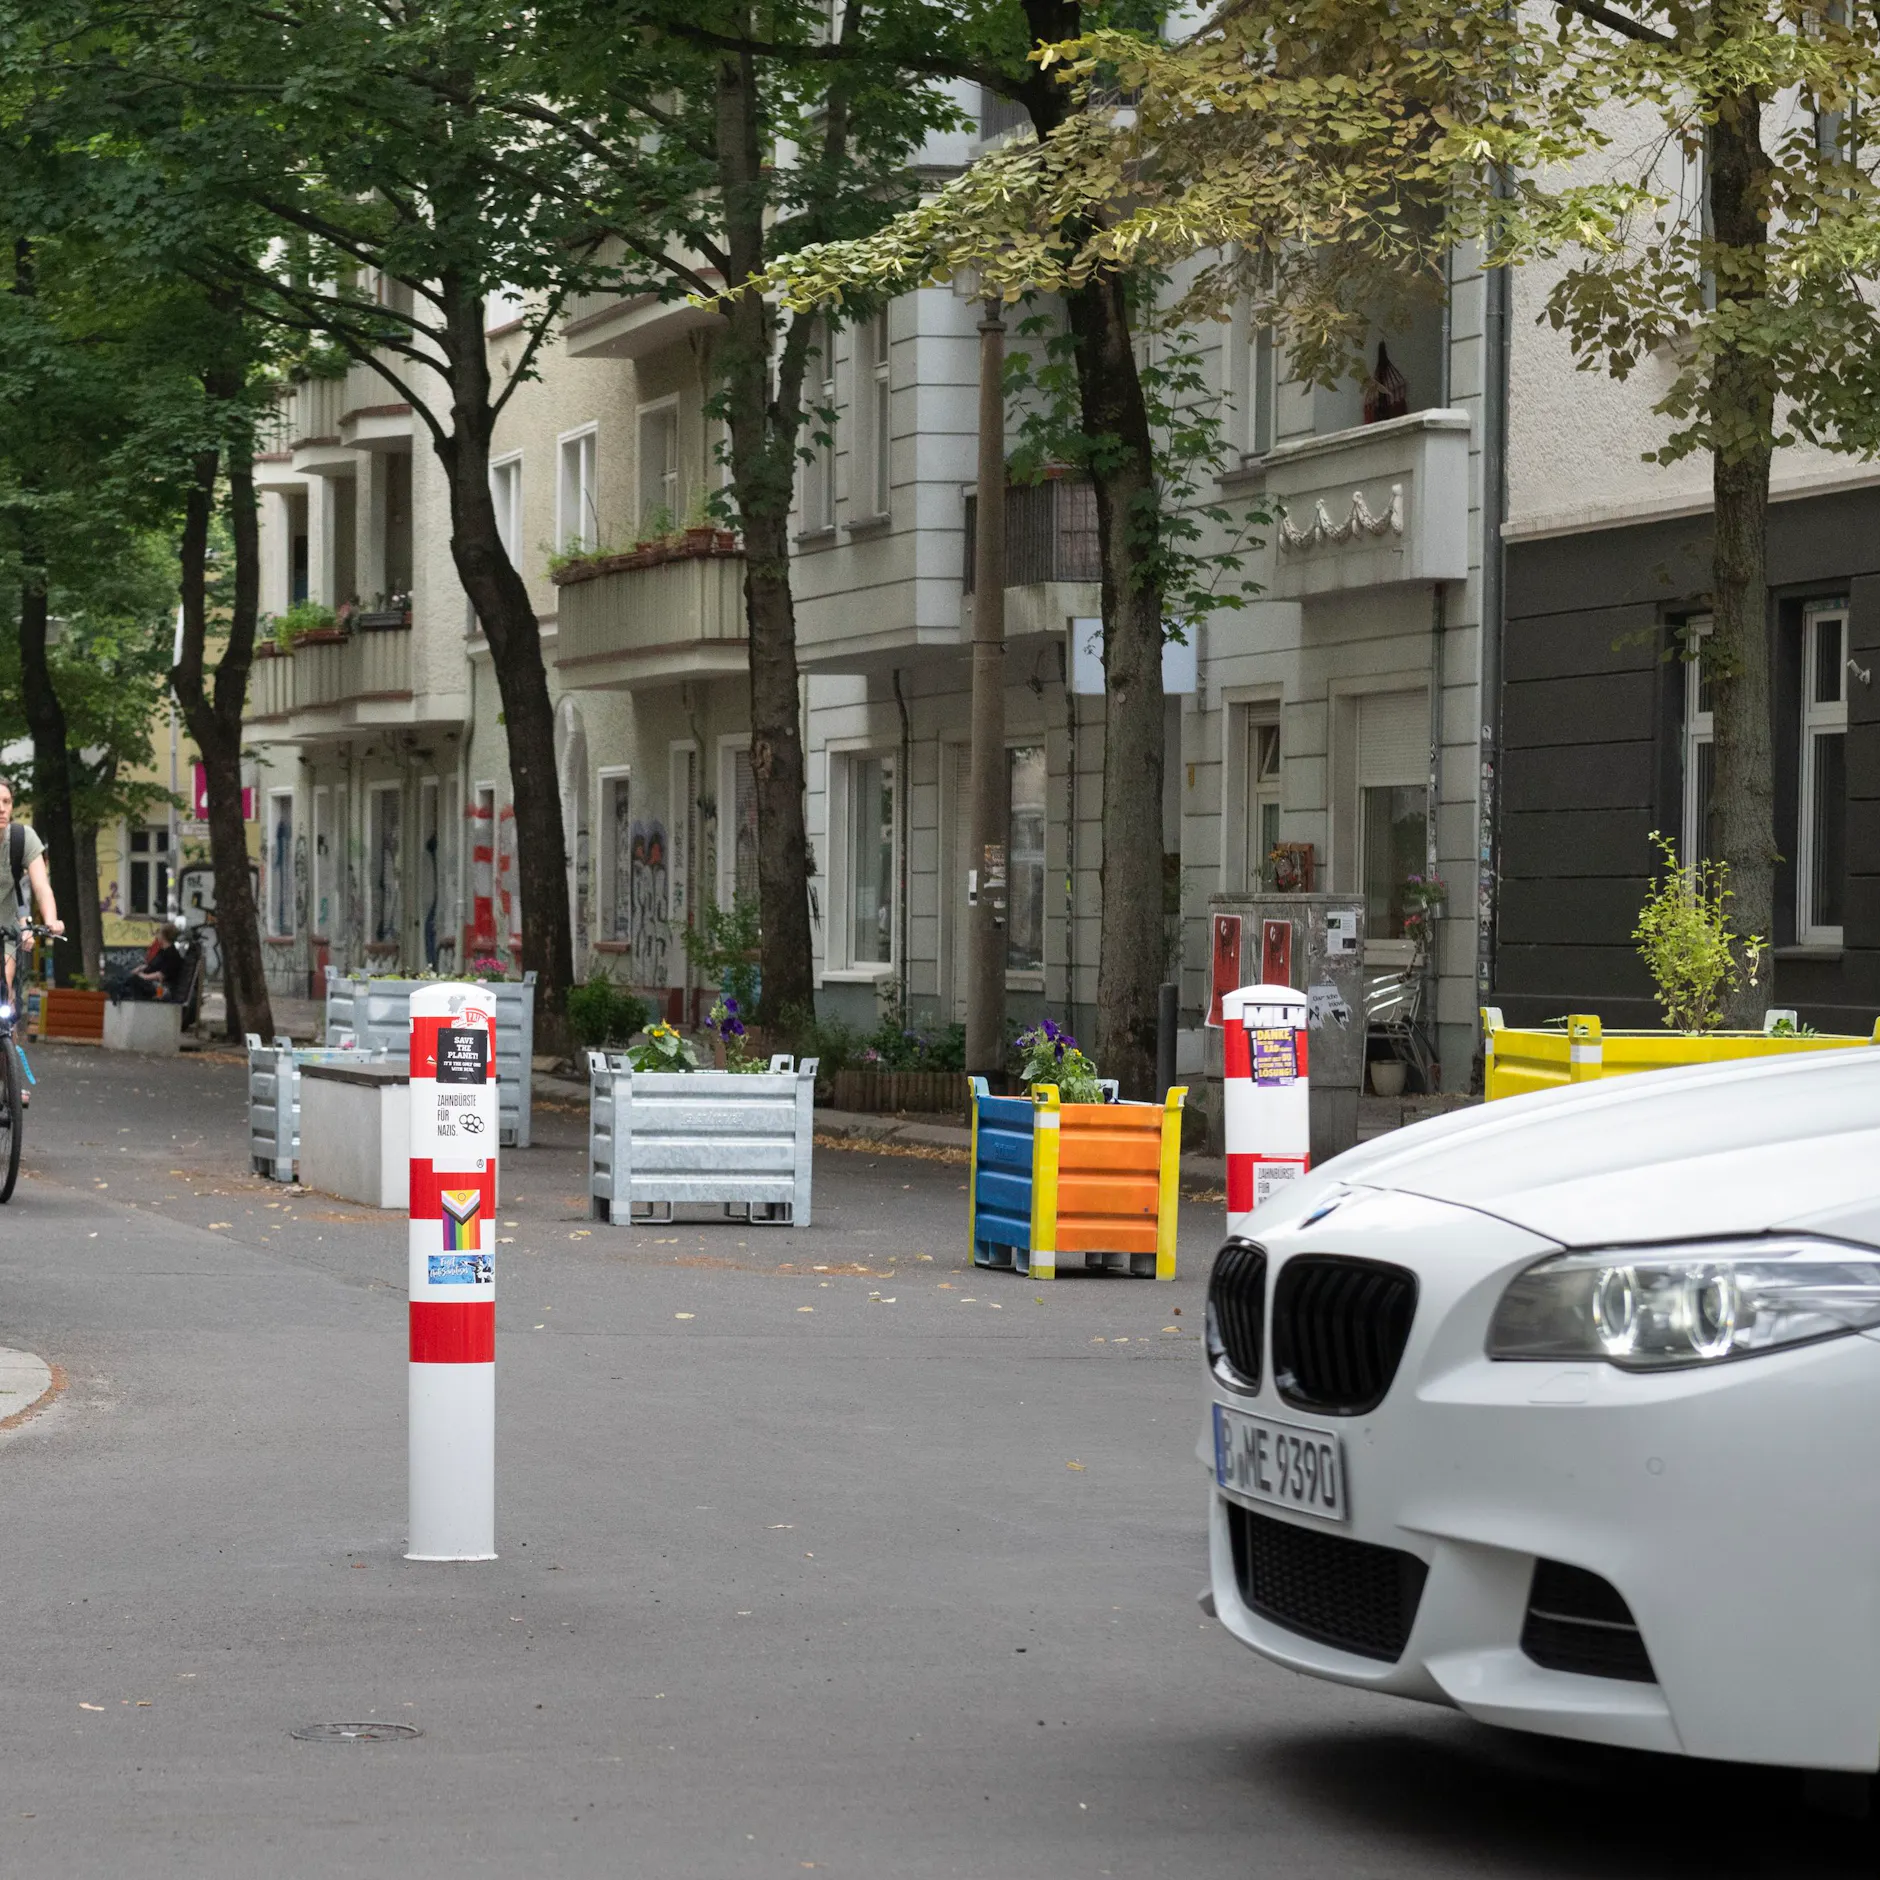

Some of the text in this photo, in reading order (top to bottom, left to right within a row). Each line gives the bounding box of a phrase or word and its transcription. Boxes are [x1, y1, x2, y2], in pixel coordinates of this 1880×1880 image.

[454, 1037, 474, 1045] SAVE
[456, 1044, 472, 1052] THE
[447, 1051, 479, 1060] PLANET!
[437, 1092, 476, 1107] ZAHNBÜRSTE
[437, 1107, 450, 1121] FÜR
[437, 1124, 458, 1136] NAZIS.
[1223, 1417, 1235, 1480] B
[1276, 1433, 1336, 1509] 9390
